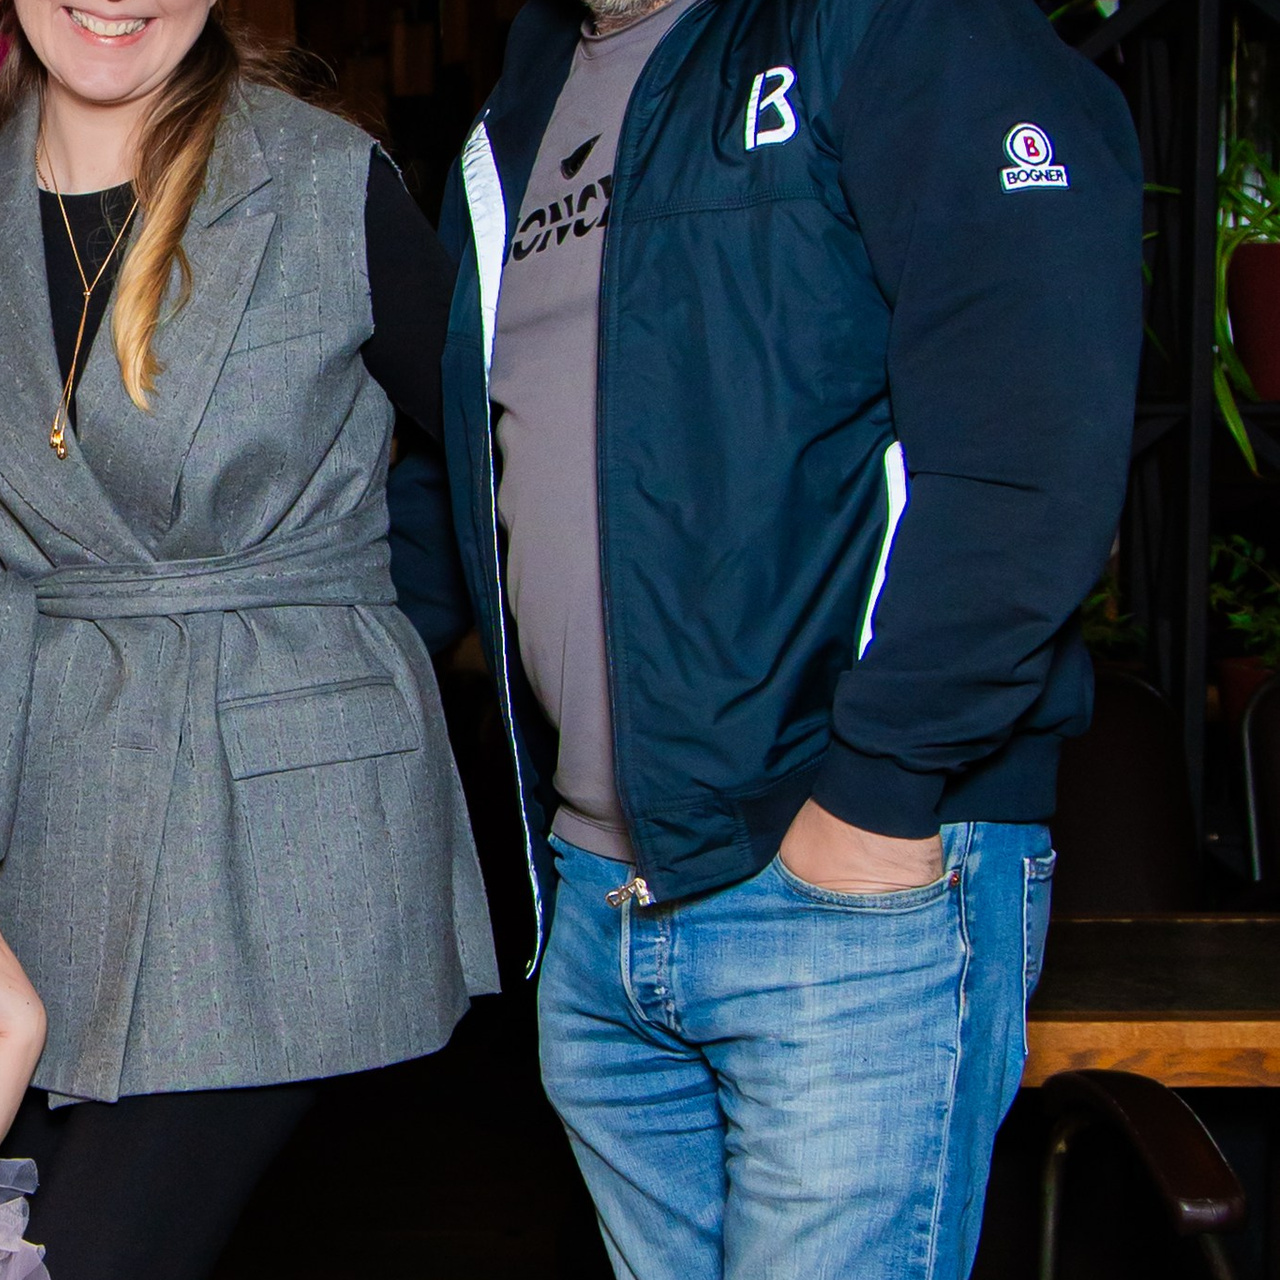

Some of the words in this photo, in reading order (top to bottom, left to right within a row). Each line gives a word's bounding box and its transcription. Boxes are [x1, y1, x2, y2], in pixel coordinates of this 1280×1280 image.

[745, 66, 798, 151] B
[1023, 136, 1040, 157] B
[1006, 169, 1065, 185] BOGNER
